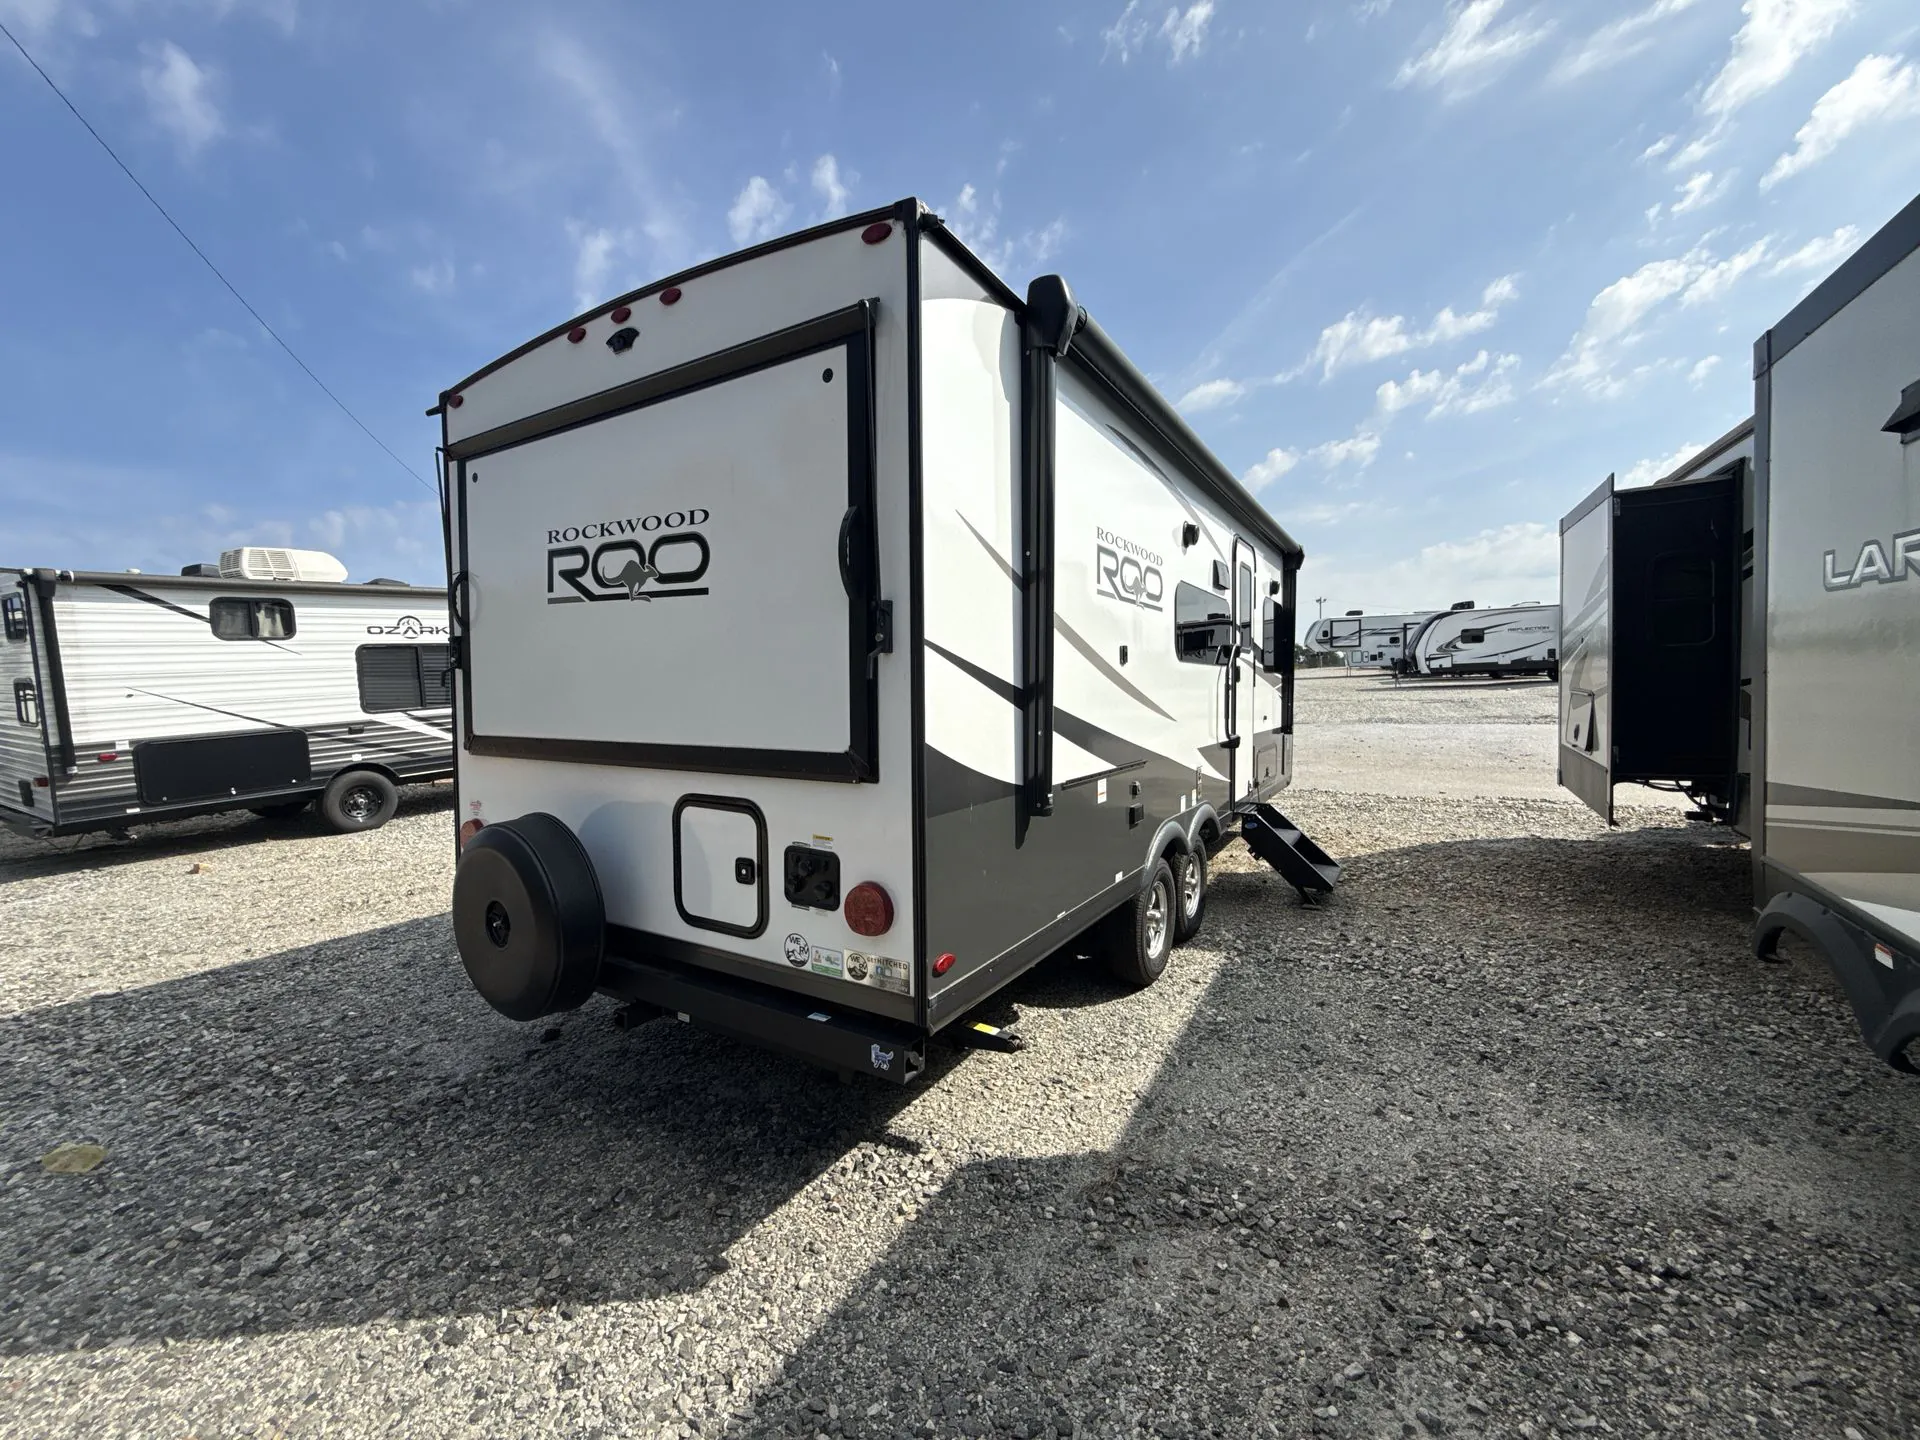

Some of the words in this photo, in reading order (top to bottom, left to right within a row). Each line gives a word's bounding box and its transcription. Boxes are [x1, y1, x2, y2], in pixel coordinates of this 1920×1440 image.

[546, 508, 710, 544] ROCKWOOD
[1096, 525, 1163, 567] ROCKWOOD
[547, 531, 711, 603] ROO
[1096, 543, 1163, 612] ROO
[366, 624, 450, 637] OZARK
[789, 936, 801, 945] WE
[850, 955, 860, 963] WE
